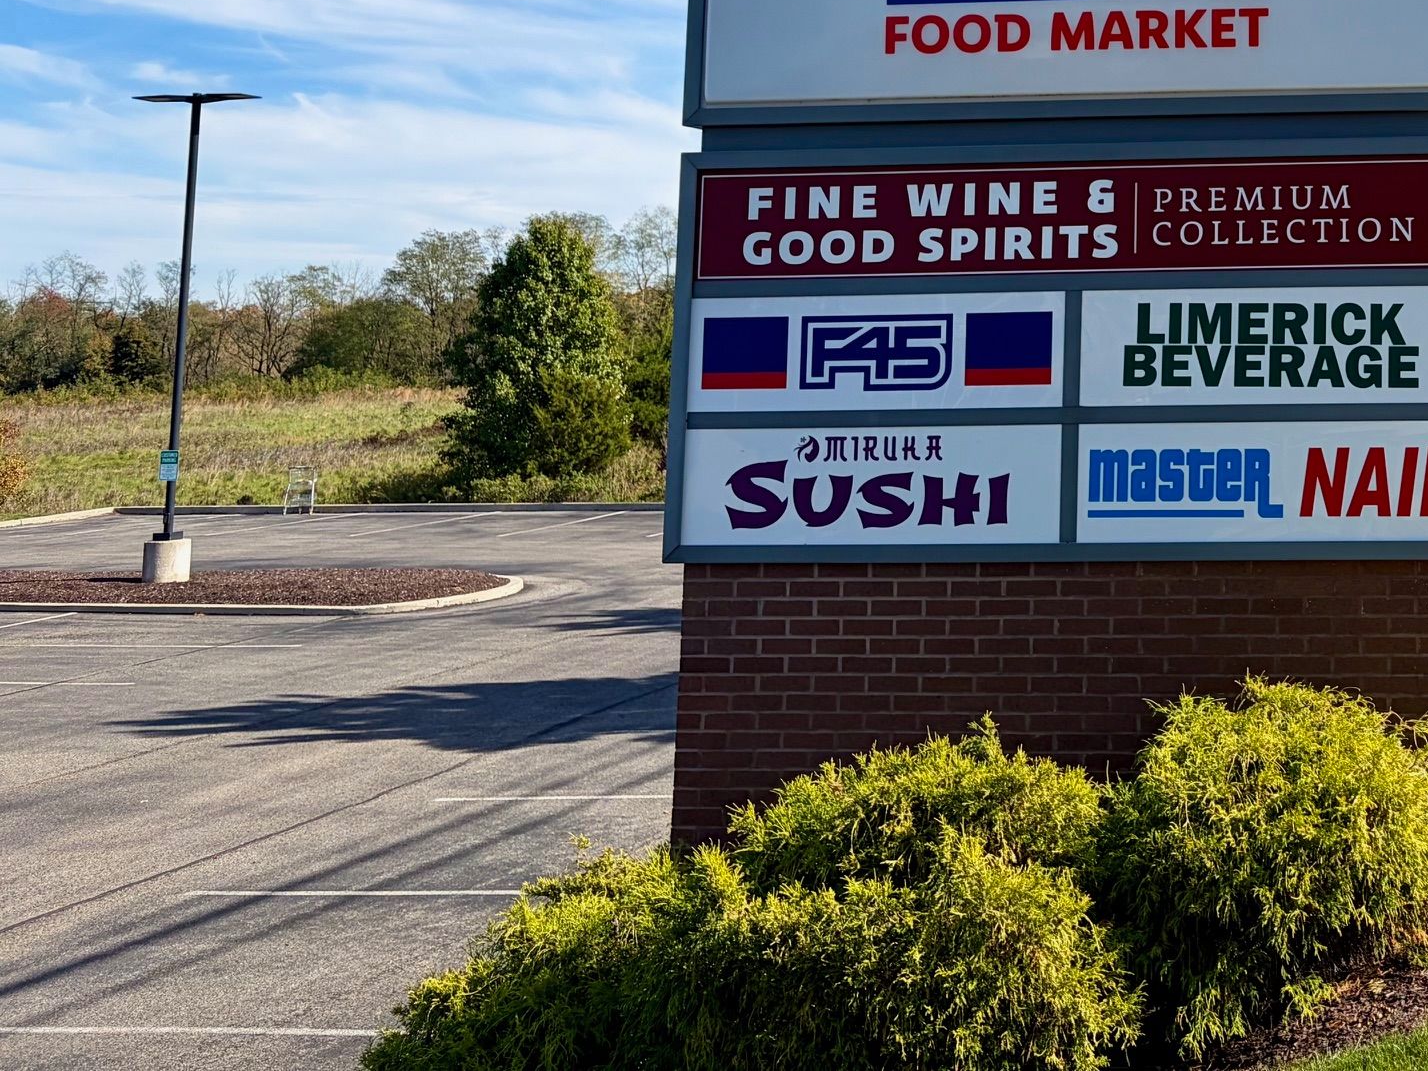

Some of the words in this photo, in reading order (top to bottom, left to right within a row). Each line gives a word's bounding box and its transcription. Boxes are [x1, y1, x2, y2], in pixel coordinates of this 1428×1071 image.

[885, 13, 1030, 54] FOOD
[1050, 7, 1269, 51] MARKET
[747, 185, 877, 220] FINE
[906, 181, 1058, 217] WINE
[1087, 179, 1114, 213] &
[1153, 185, 1351, 212] PREMIUM
[742, 229, 895, 265] GOOD
[917, 224, 1119, 263] SPIRITS
[1152, 217, 1415, 246] COLLECTION
[1136, 302, 1407, 345] LIMERICK
[804, 317, 949, 387] F45
[1122, 345, 1420, 388] BEVERAGE
[724, 459, 1010, 530] SUSHI
